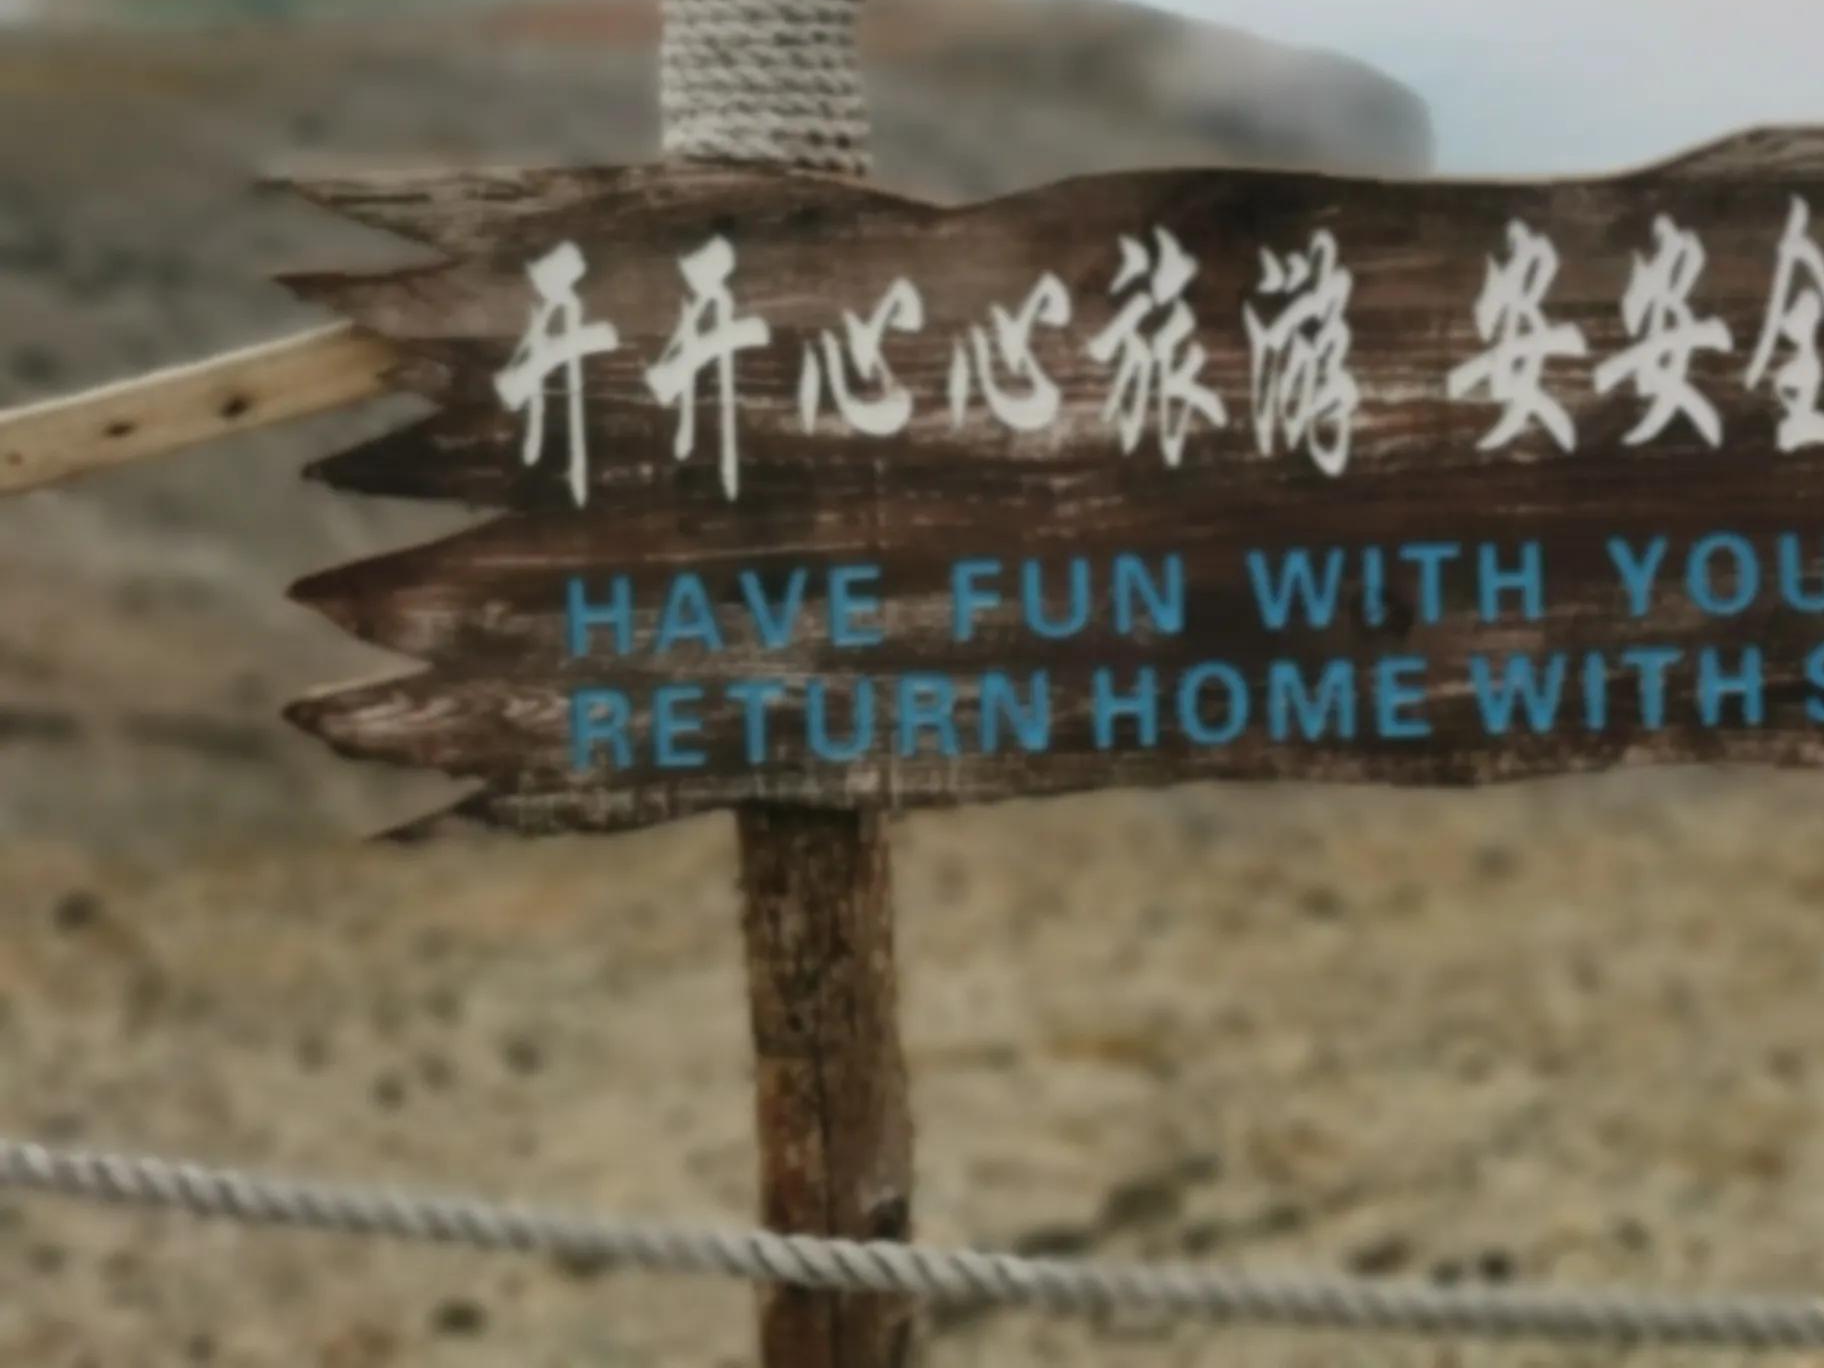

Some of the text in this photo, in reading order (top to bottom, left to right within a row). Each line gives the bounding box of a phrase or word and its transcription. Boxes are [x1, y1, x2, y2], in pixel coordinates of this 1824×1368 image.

[494, 226, 1360, 506] 开开心心旅游
[565, 563, 883, 656] HAVE
[950, 551, 1187, 641] FUN
[1246, 539, 1545, 633] WITH
[569, 669, 1052, 770] RETURN
[1092, 654, 1431, 750] HOME
[1469, 645, 1767, 736] WITH
